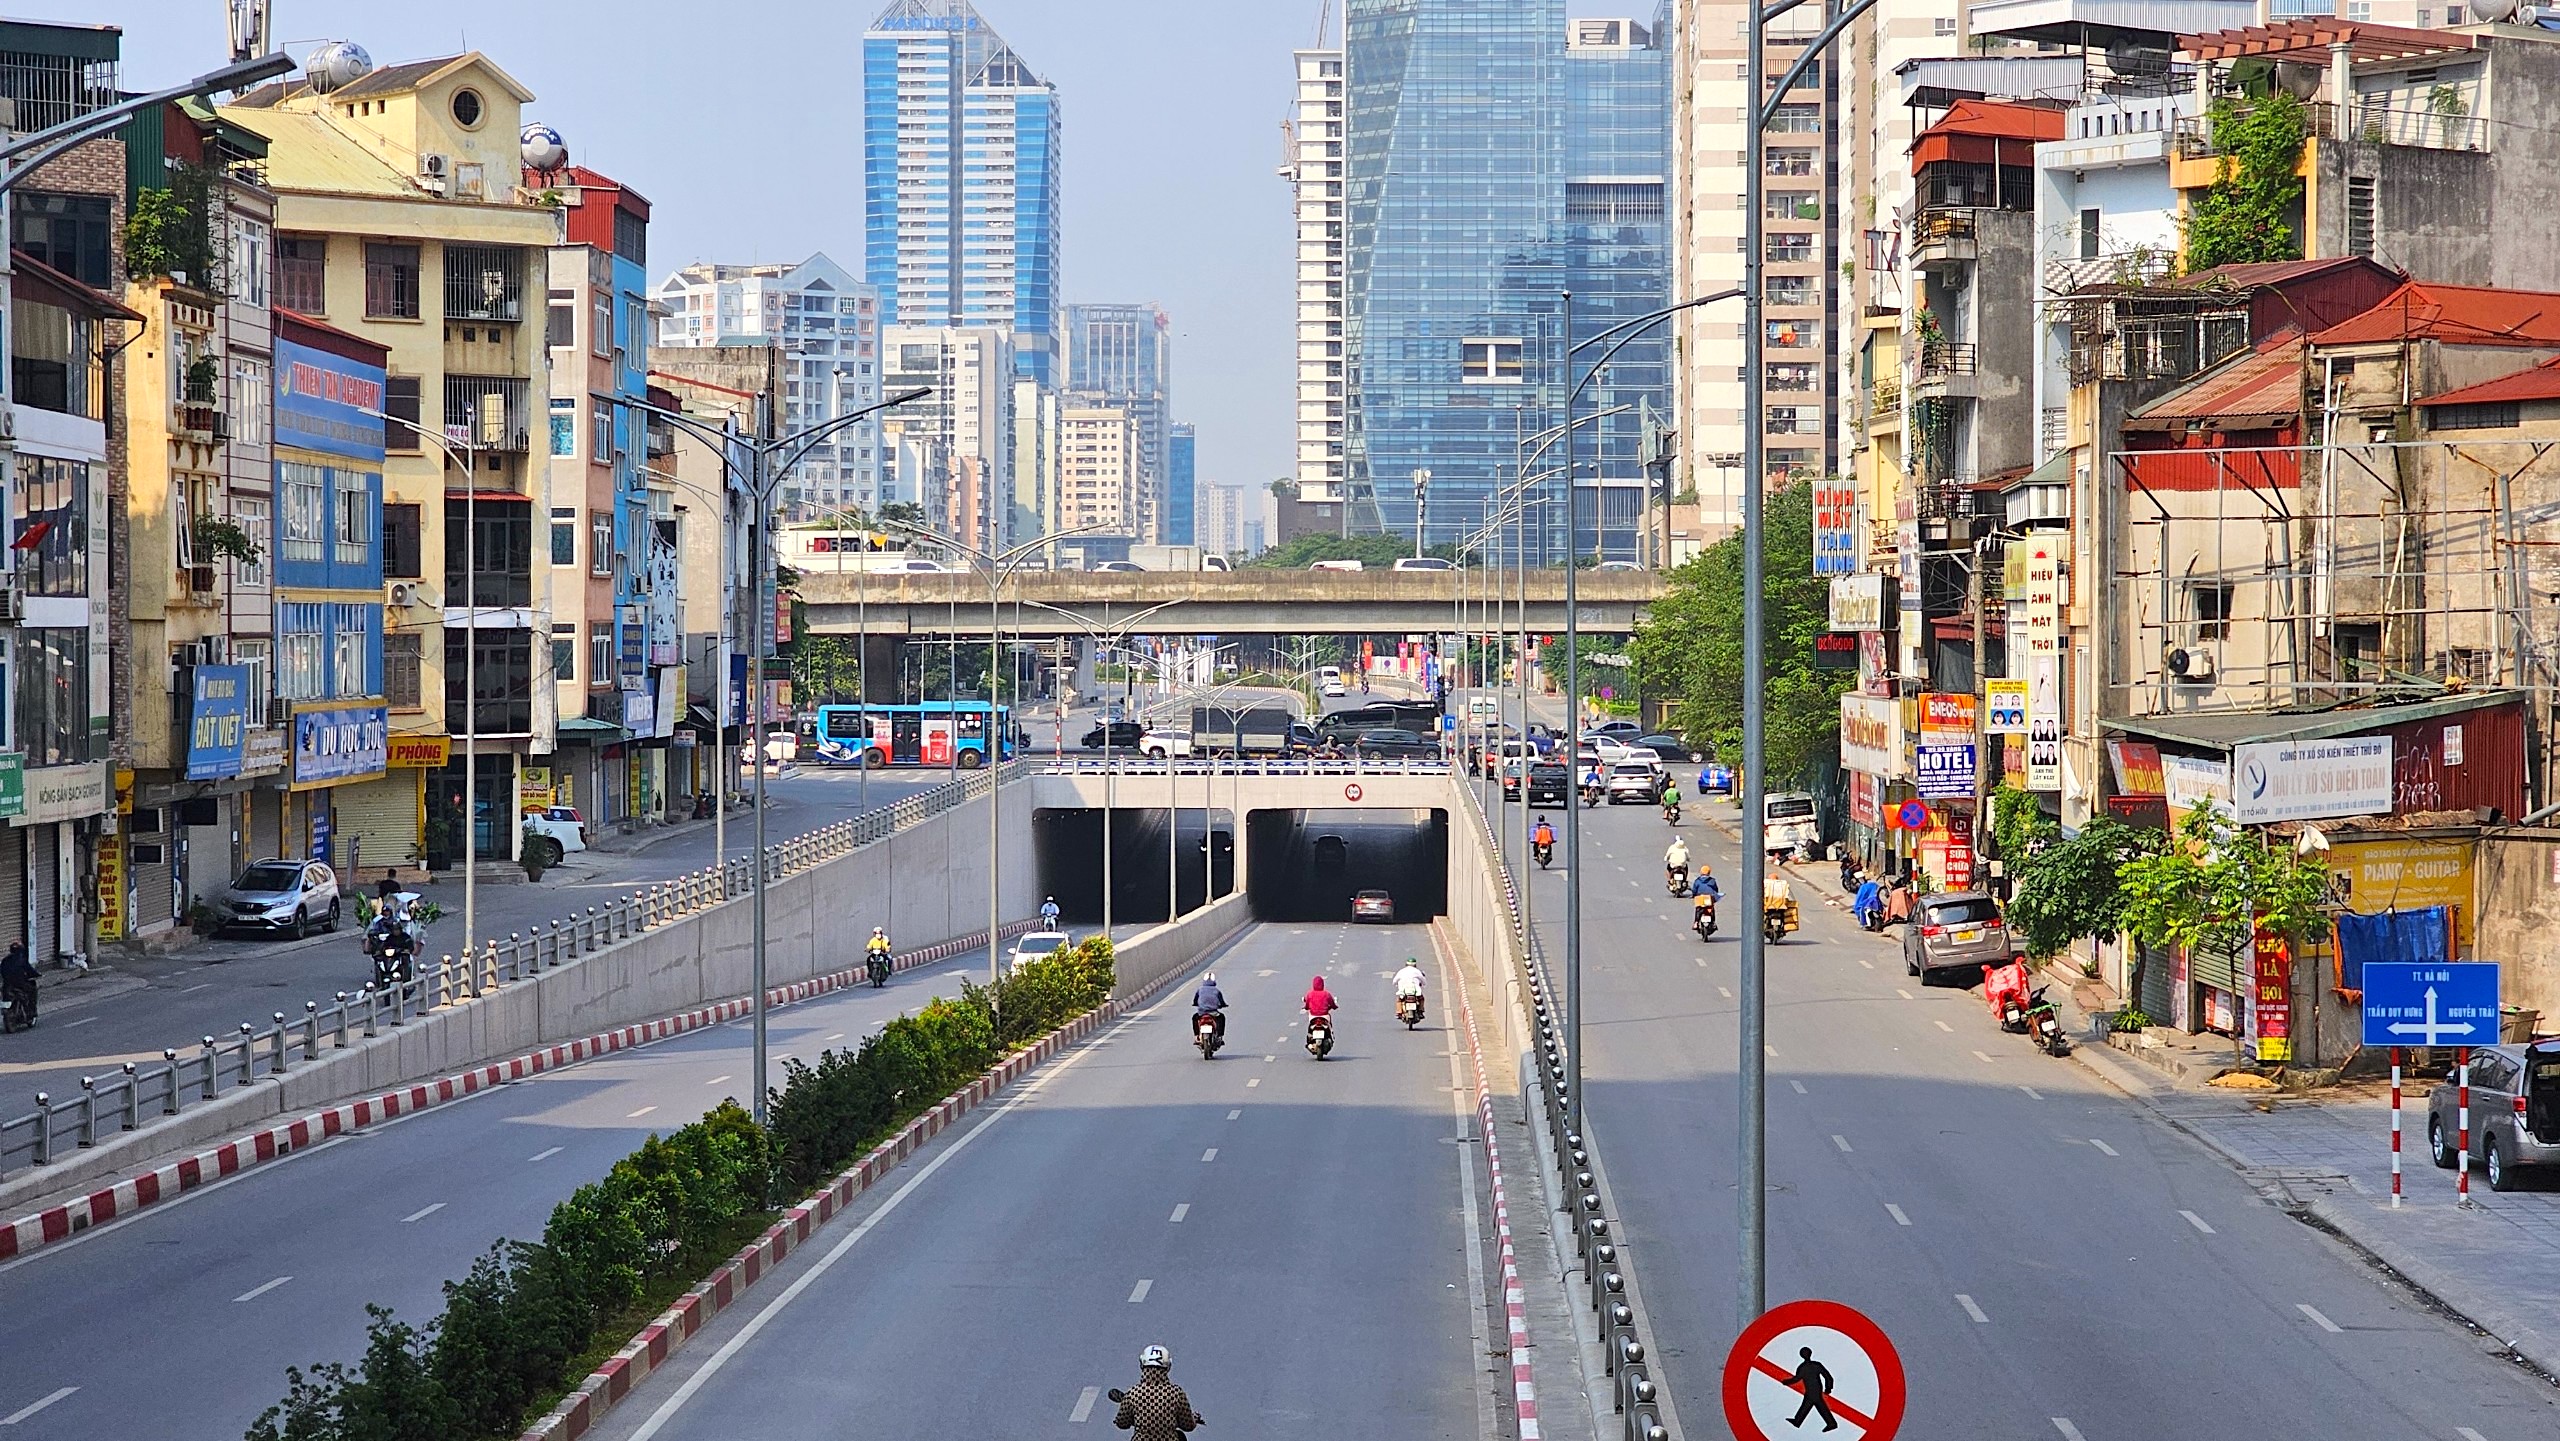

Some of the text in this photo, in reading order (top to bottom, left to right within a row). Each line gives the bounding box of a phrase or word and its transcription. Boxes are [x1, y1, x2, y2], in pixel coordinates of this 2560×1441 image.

[1815, 487, 1854, 507] KÍNH
[1818, 504, 1852, 528] MẮT
[806, 537, 871, 553] HDBank
[1818, 532, 1852, 551] TÂM
[1815, 555, 1856, 575] MINH
[2031, 568, 2053, 583] HIỆU
[2031, 591, 2051, 604] ẢNH
[2031, 637, 2054, 650] TRỜI
[1929, 701, 1959, 719] ENEOS
[195, 705, 241, 753] ĐẤT VIỆT
[322, 725, 337, 756] DU
[340, 722, 361, 759] HỌC
[396, 741, 442, 760] PHÒNG
[2280, 751, 2297, 762] CÔNG
[2299, 750, 2306, 760] TY
[2316, 745, 2326, 759] SỐ
[2326, 744, 2341, 758] KIẾN
[2342, 742, 2359, 757] THIẾT
[2361, 742, 2372, 756] THỦ
[2373, 743, 2382, 755] ĐÔ
[1918, 752, 1973, 770] HOTEL
[2272, 774, 2289, 802] ĐẠI
[2291, 770, 2303, 796] LÝ
[2320, 763, 2334, 794] SỐ
[2336, 764, 2359, 797] ĐIỆN
[2360, 763, 2386, 790] TOÁN
[1949, 848, 1967, 859] SỬA
[1946, 860, 1969, 871] CHỮA
[2364, 862, 2403, 882] PIANO
[2414, 860, 2461, 879] GUITAR
[1946, 872, 1969, 882] XE MÁY
[2412, 971, 2423, 982] TT.
[2424, 968, 2435, 982] HÀ
[2388, 1007, 2402, 1018] DUY
